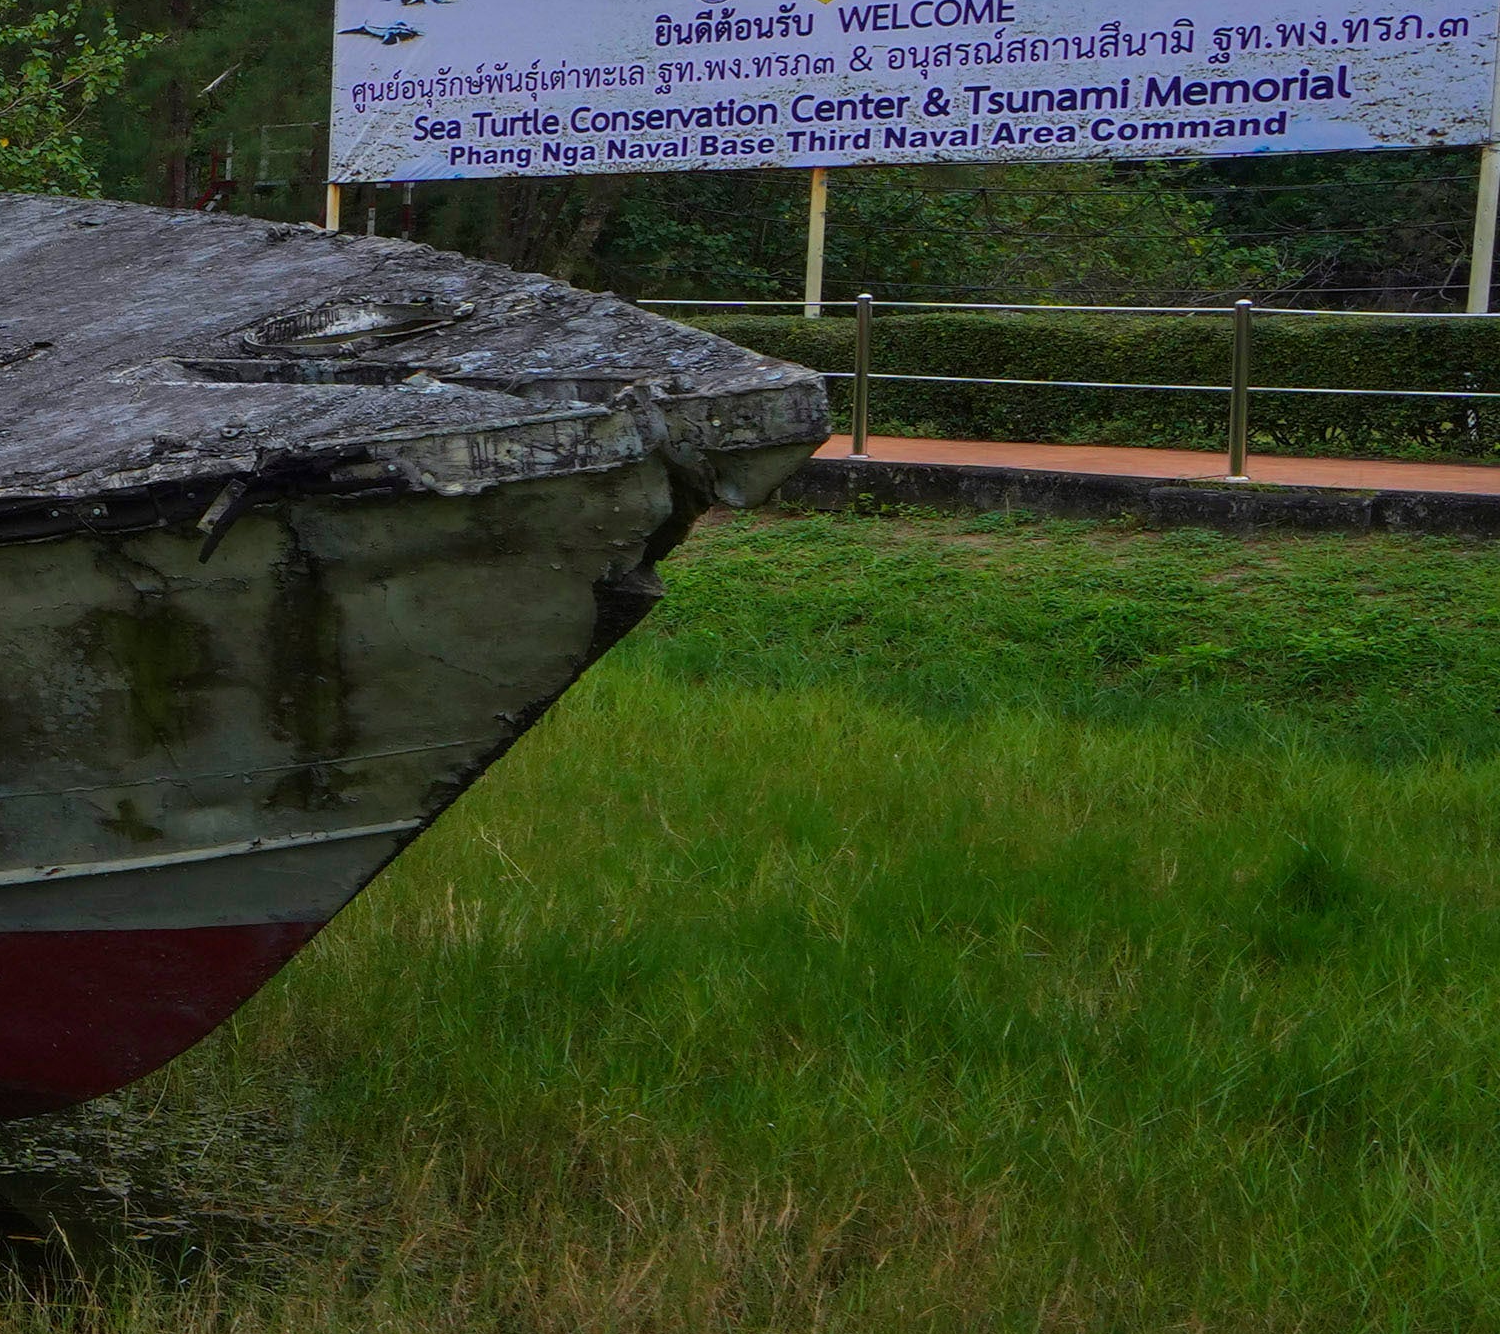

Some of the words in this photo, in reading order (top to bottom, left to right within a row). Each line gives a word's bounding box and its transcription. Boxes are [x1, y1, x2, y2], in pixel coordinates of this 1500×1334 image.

[655, 3, 814, 47] ยินดีต้อนรับ
[352, 59, 644, 113] ศูนย์อนุรักษ์พันธุ์เต่าทะเล
[849, 46, 873, 72] &
[888, 18, 1194, 80] อนุสรณ์สถานสึนามิ
[1208, 14, 1469, 64] ฐท.พง.ทรภ.๓
[413, 115, 461, 141] Sea
[472, 108, 560, 138] Turtle
[570, 98, 777, 133] Conservation
[791, 94, 910, 123] Center
[922, 87, 951, 117] &
[964, 78, 1130, 115] Tsunami
[1144, 65, 1351, 108] Memorial
[450, 145, 531, 168] Phang
[542, 142, 595, 166] Nga
[607, 136, 688, 160] Naval
[699, 135, 775, 156] Base
[787, 128, 871, 152] Third
[884, 124, 979, 149] Naval
[991, 122, 1076, 145] Area
[1090, 111, 1287, 142] Command
